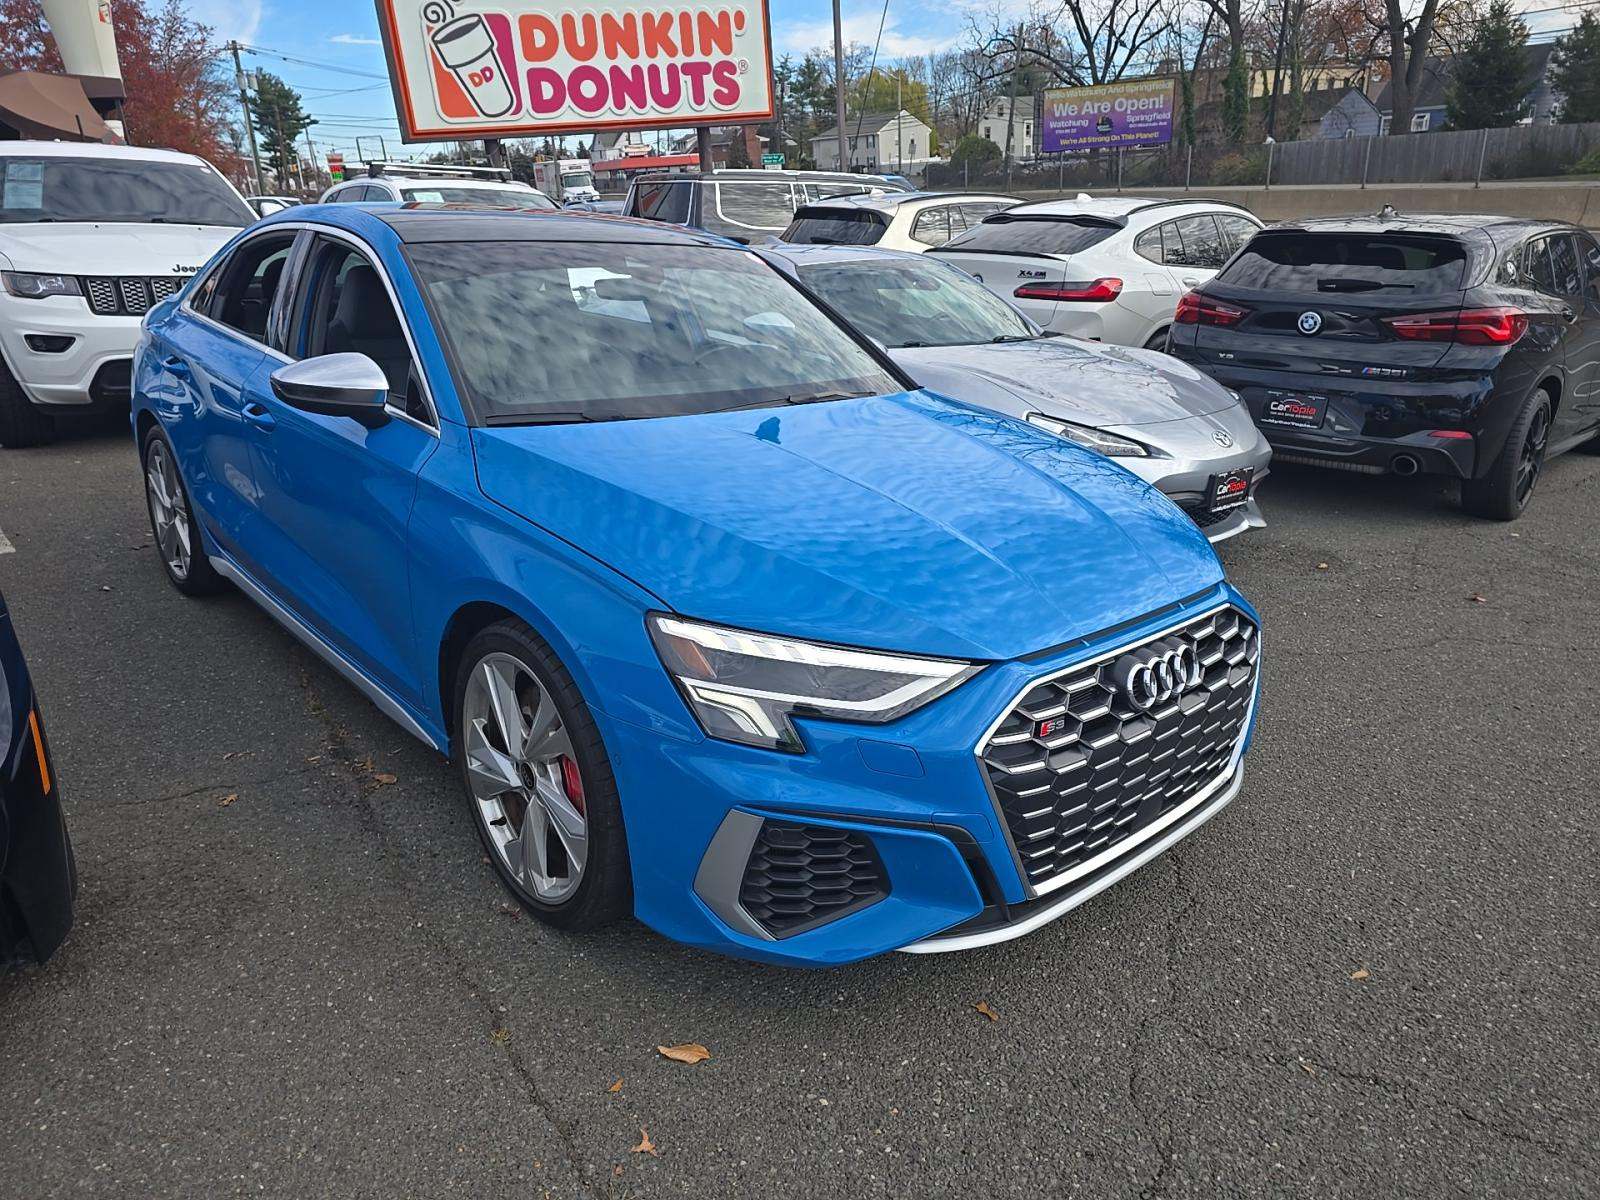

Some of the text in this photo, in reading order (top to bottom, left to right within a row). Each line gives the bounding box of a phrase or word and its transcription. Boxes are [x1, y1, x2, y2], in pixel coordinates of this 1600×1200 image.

[518, 9, 745, 62] DUNKIN'
[468, 66, 494, 88] DD
[526, 60, 741, 114] DONUTS
[1053, 94, 1164, 117] We Are Open!
[1049, 118, 1089, 129] Watchung
[1126, 112, 1171, 122] Springfield
[1046, 719, 1064, 732] S3
